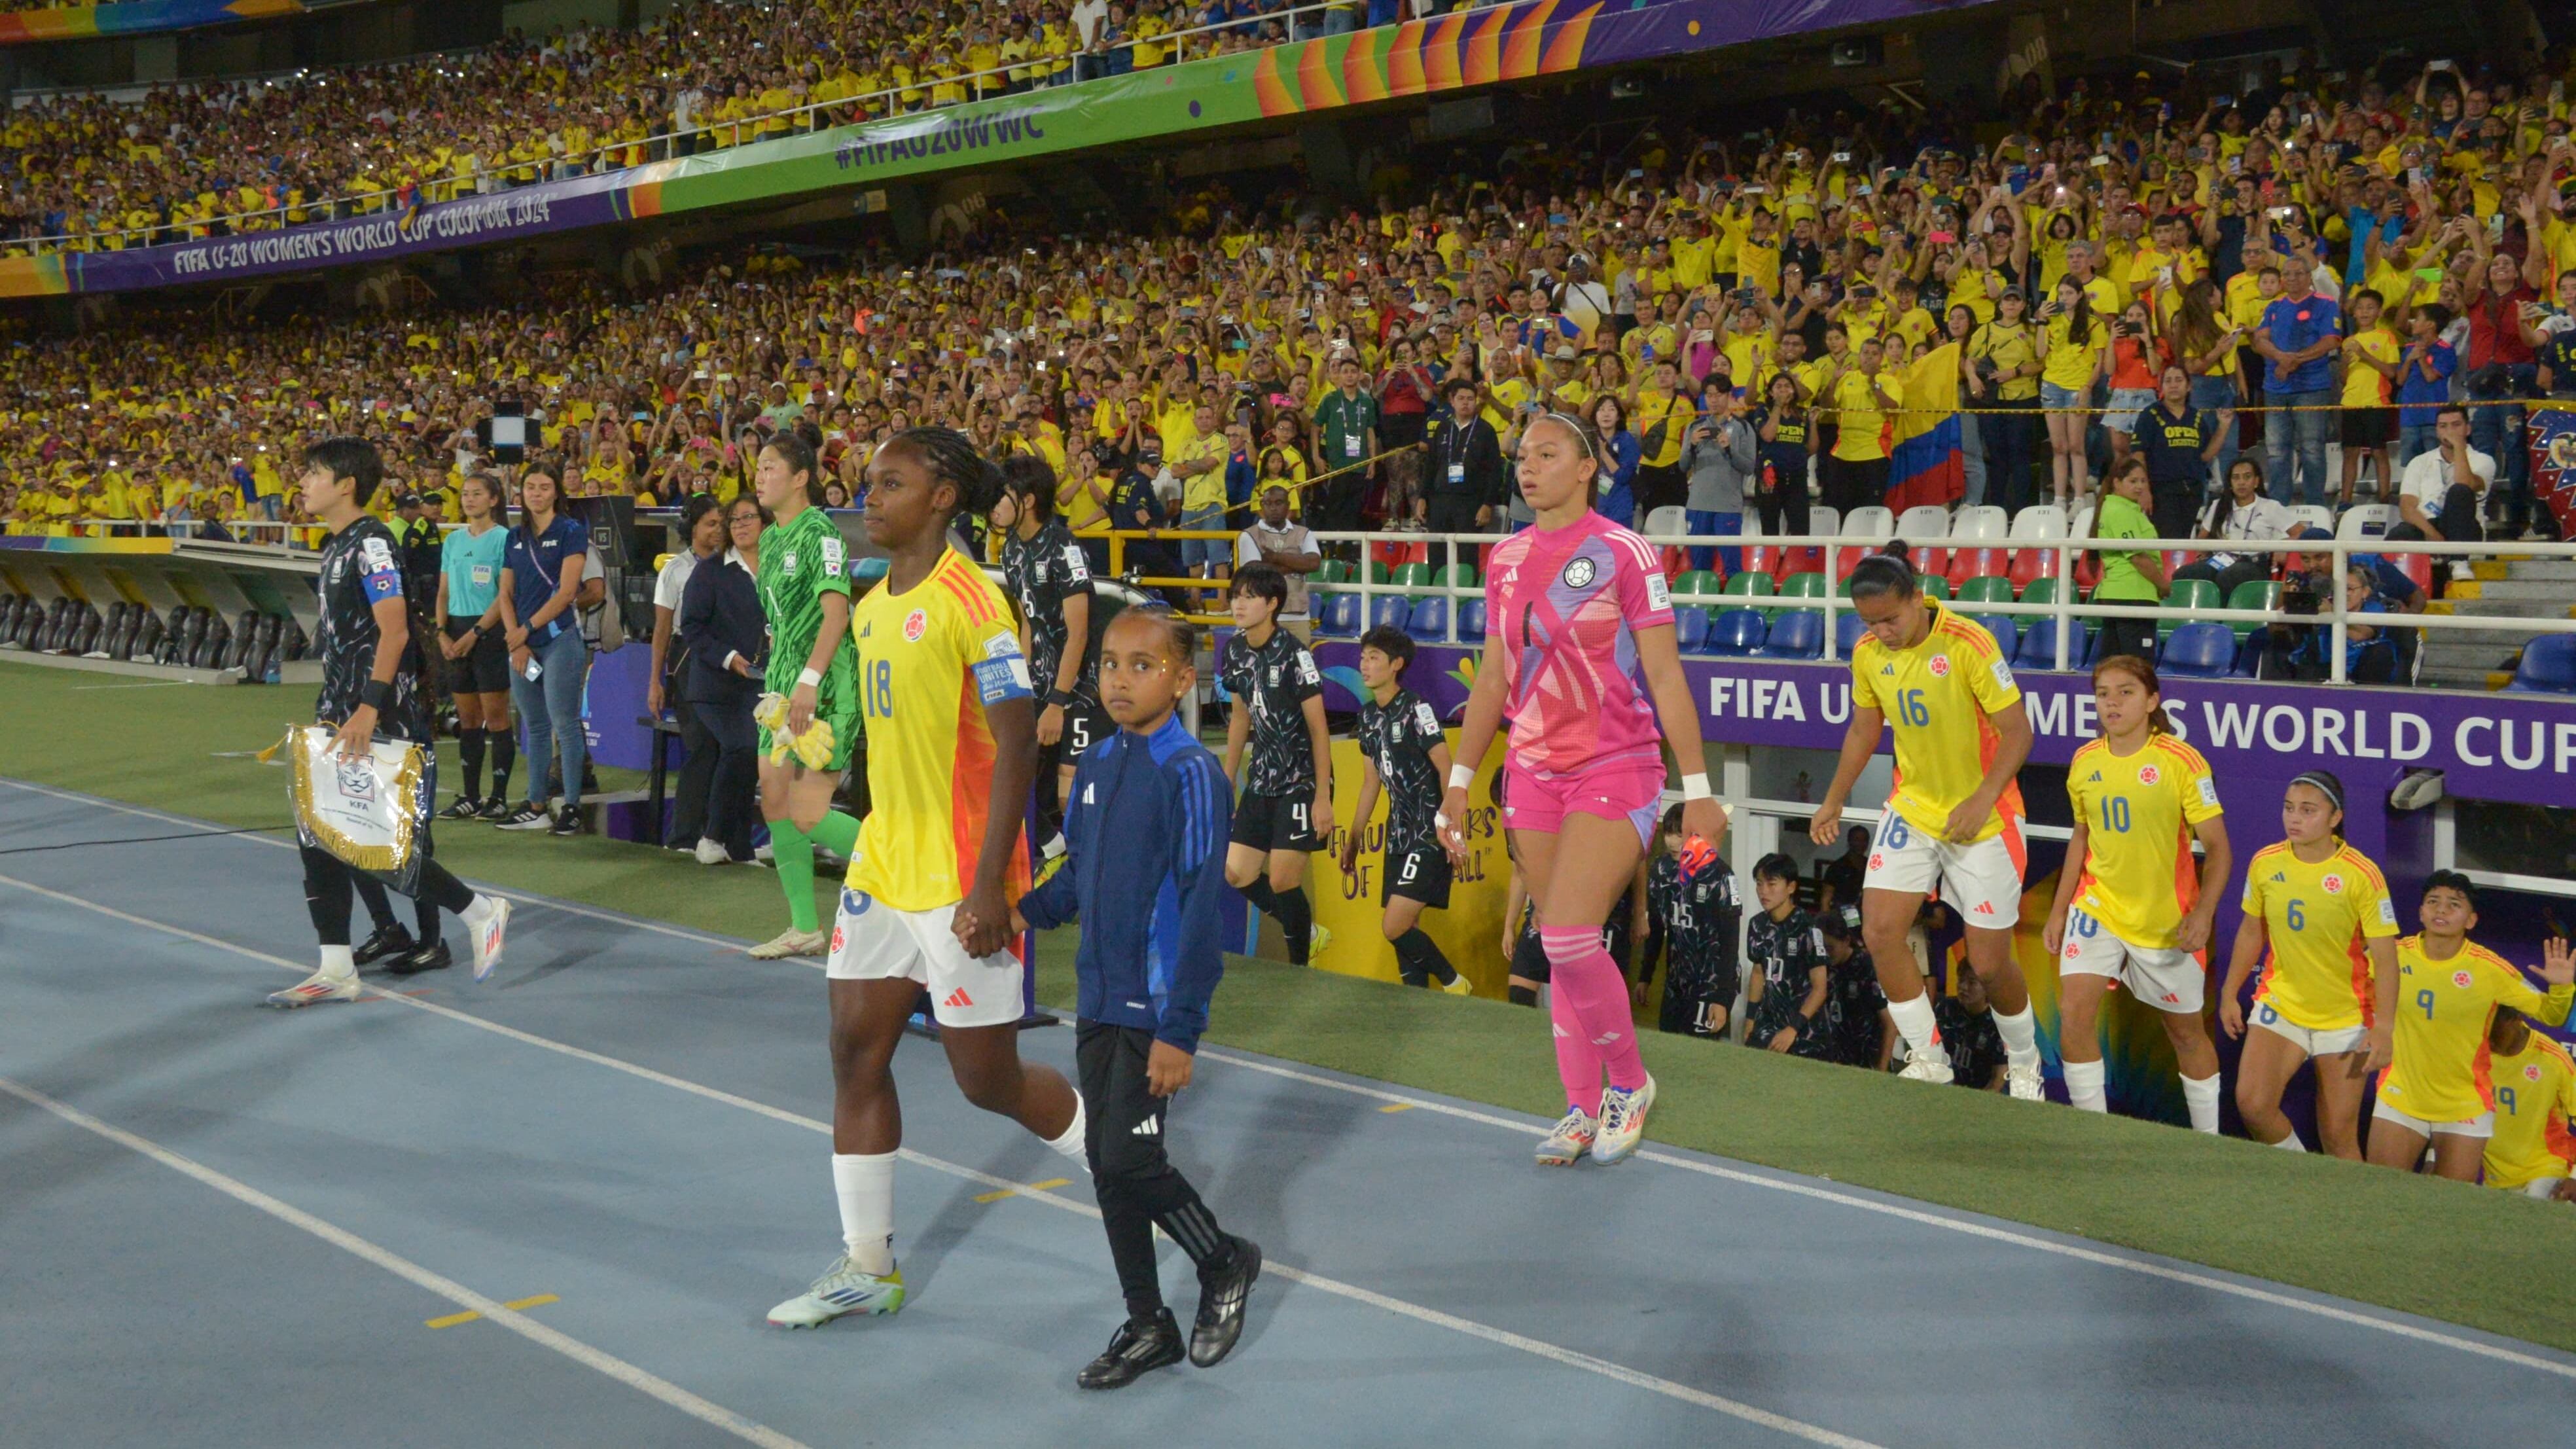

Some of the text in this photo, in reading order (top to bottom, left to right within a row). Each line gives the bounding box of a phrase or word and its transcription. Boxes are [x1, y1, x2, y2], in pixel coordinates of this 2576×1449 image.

[835, 104, 1044, 170] #FIFAU20WWC
[174, 247, 211, 274] FIFA
[212, 242, 247, 270] U-20
[251, 230, 332, 264] WOMEN'S
[334, 221, 397, 254] WORLD
[437, 200, 511, 238] COLOMBIA
[2164, 426, 2200, 438] OPEN
[867, 659, 893, 719] 18
[979, 668, 1012, 684] UNITES
[986, 690, 1003, 700] FIFA
[1897, 689, 1929, 727] 16
[1072, 718, 1089, 747] 5
[1710, 677, 1806, 722] FIFA
[2202, 701, 2433, 760] WORLD
[2454, 716, 2576, 774] CUP
[1381, 750, 1393, 776] 6
[349, 800, 369, 812] KFA
[1292, 803, 1307, 831] 4
[2102, 795, 2131, 833] 10
[1878, 812, 1908, 850] 16
[1402, 853, 1421, 880] 6
[1342, 866, 1373, 900] OF
[1671, 901, 1693, 929] 15
[2069, 908, 2098, 938] 10
[2287, 899, 2305, 932] 6
[1766, 957, 1784, 982] 17
[2417, 989, 2435, 1020] 9
[2492, 1086, 2516, 1116] 19
